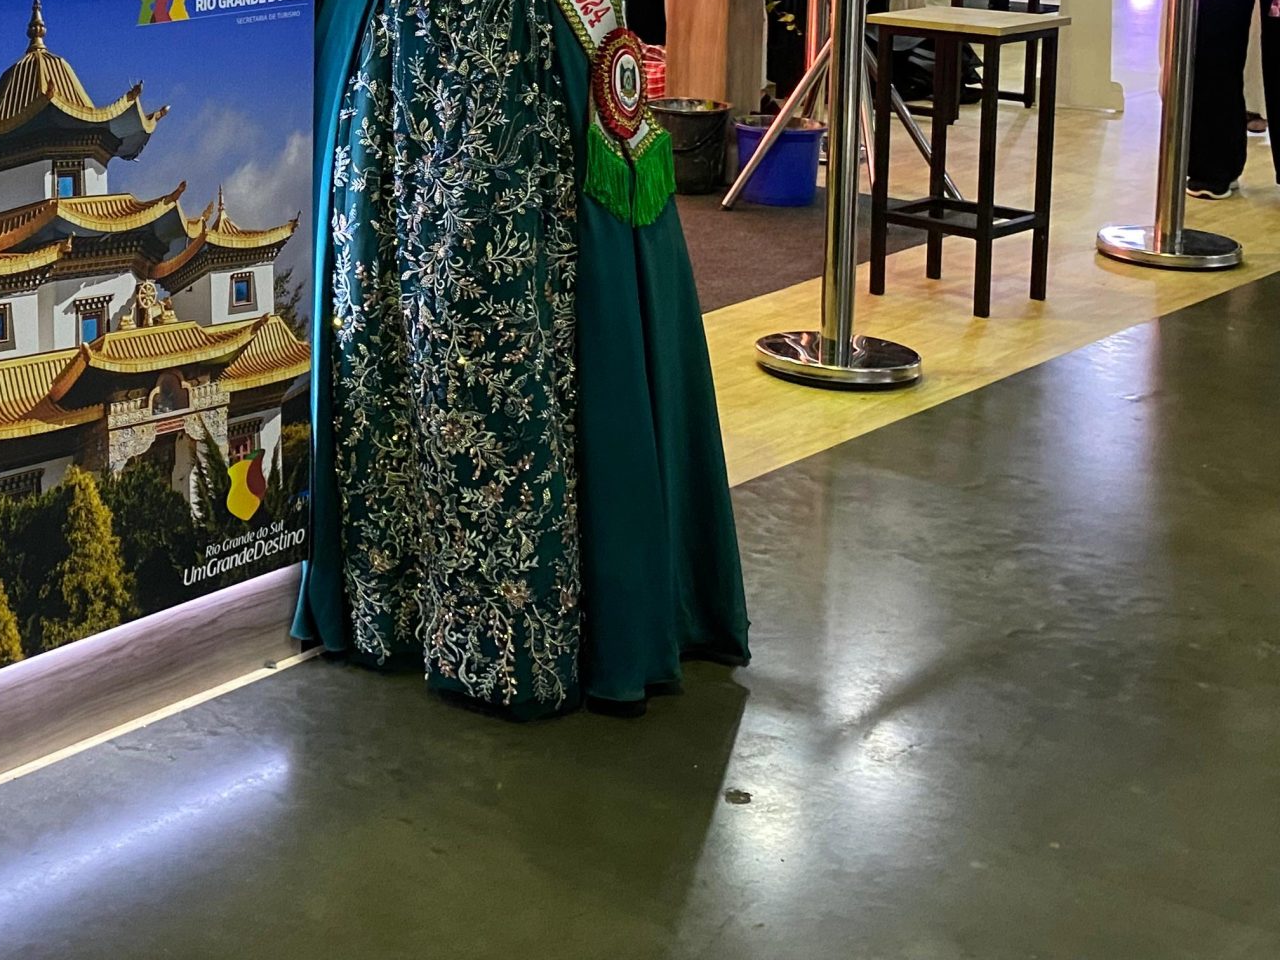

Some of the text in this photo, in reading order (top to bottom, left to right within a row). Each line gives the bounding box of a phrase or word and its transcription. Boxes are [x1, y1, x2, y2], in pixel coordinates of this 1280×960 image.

[236, 10, 301, 25] SECRETARIA DE TURISMO
[206, 520, 284, 559] Rio Grande do Sul
